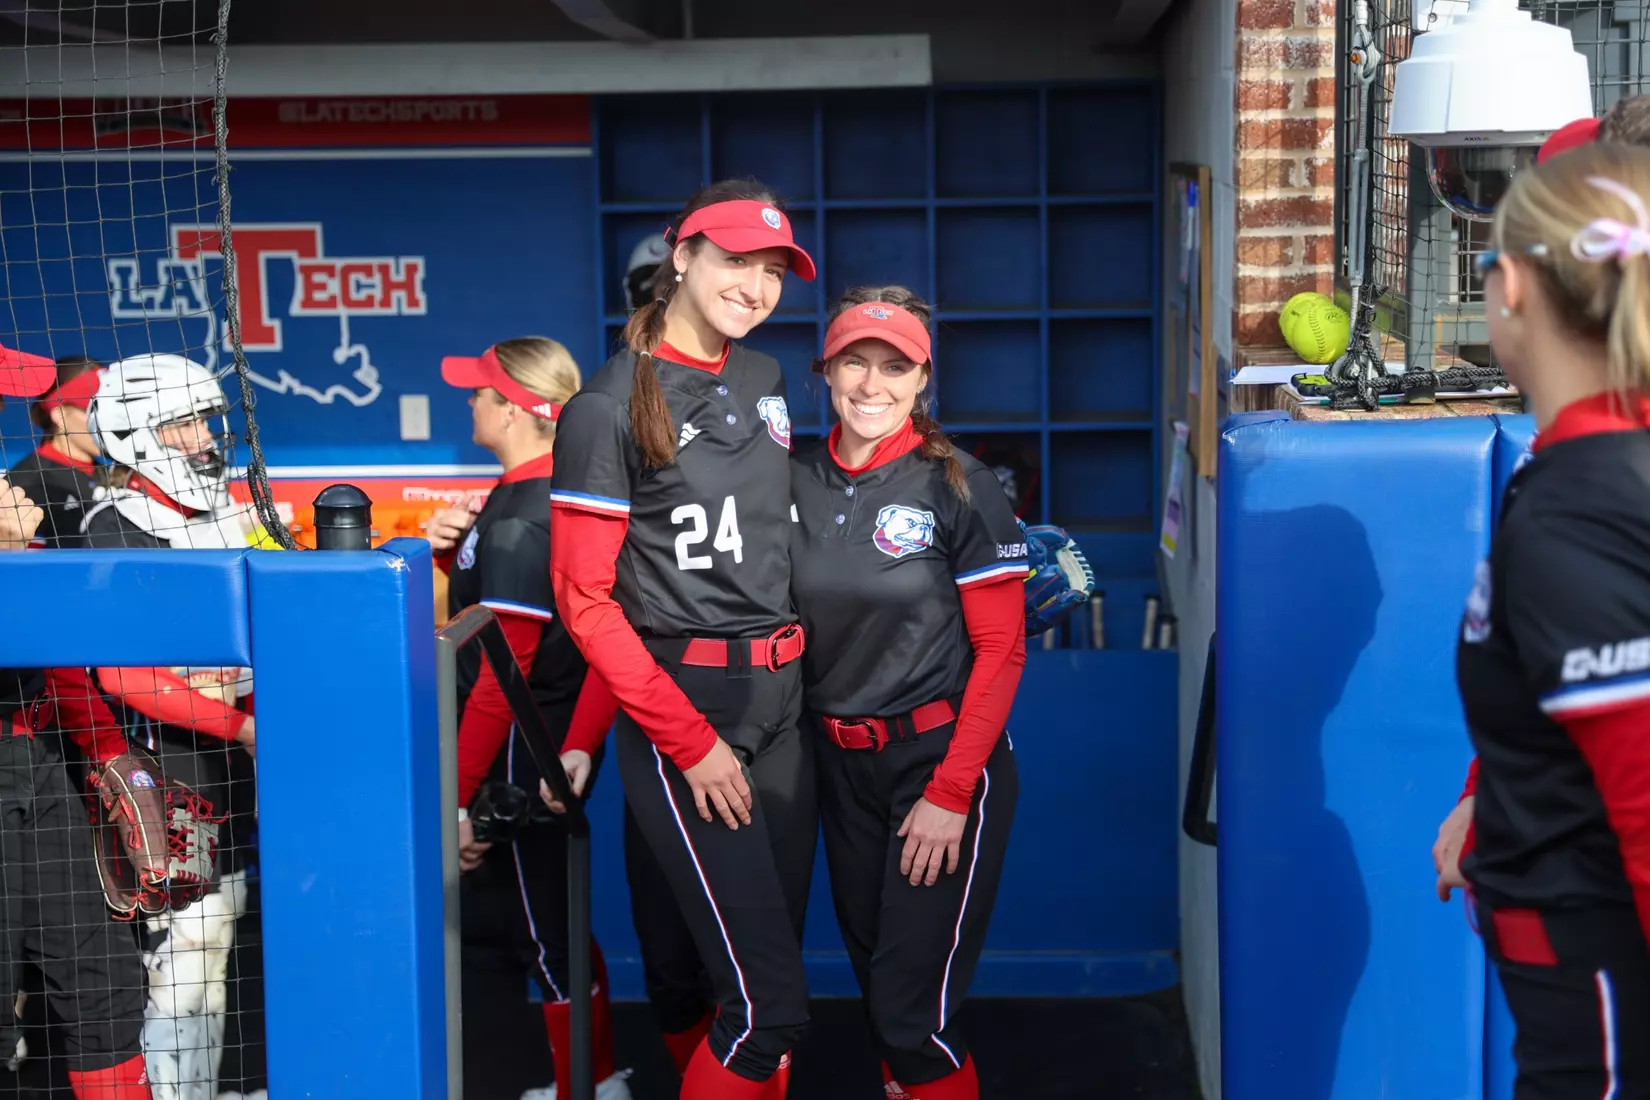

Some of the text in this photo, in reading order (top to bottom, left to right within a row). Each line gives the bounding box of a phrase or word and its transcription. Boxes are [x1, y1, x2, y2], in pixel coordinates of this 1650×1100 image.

[278, 101, 498, 122] @LATECHSPORTS
[108, 222, 427, 352] LA TECH
[670, 495, 743, 571] 24
